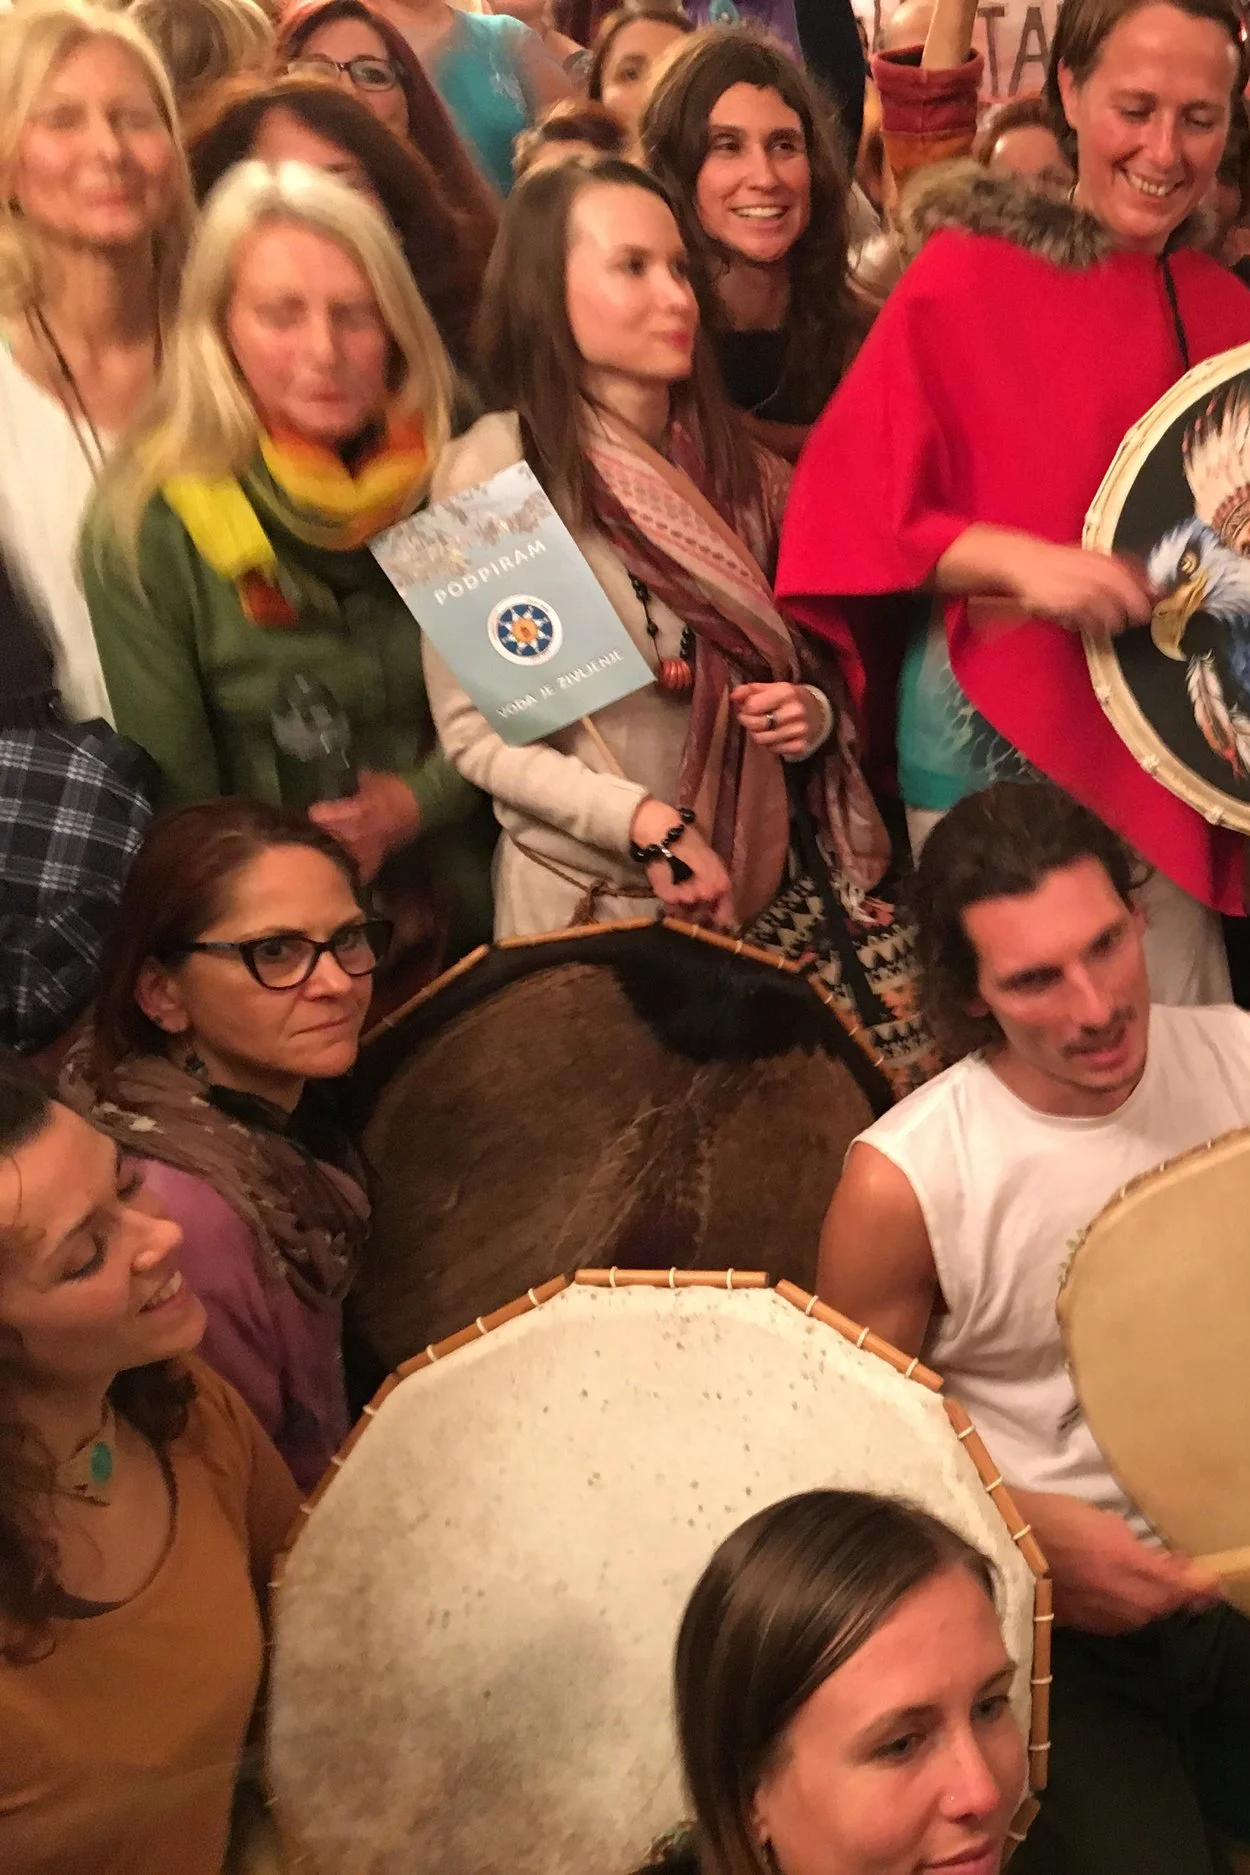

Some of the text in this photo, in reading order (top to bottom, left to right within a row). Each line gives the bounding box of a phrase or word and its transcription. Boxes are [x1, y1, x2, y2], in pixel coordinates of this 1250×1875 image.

[434, 540, 546, 606] PODPIRAM
[496, 693, 538, 719] VODA
[540, 683, 556, 699] JE
